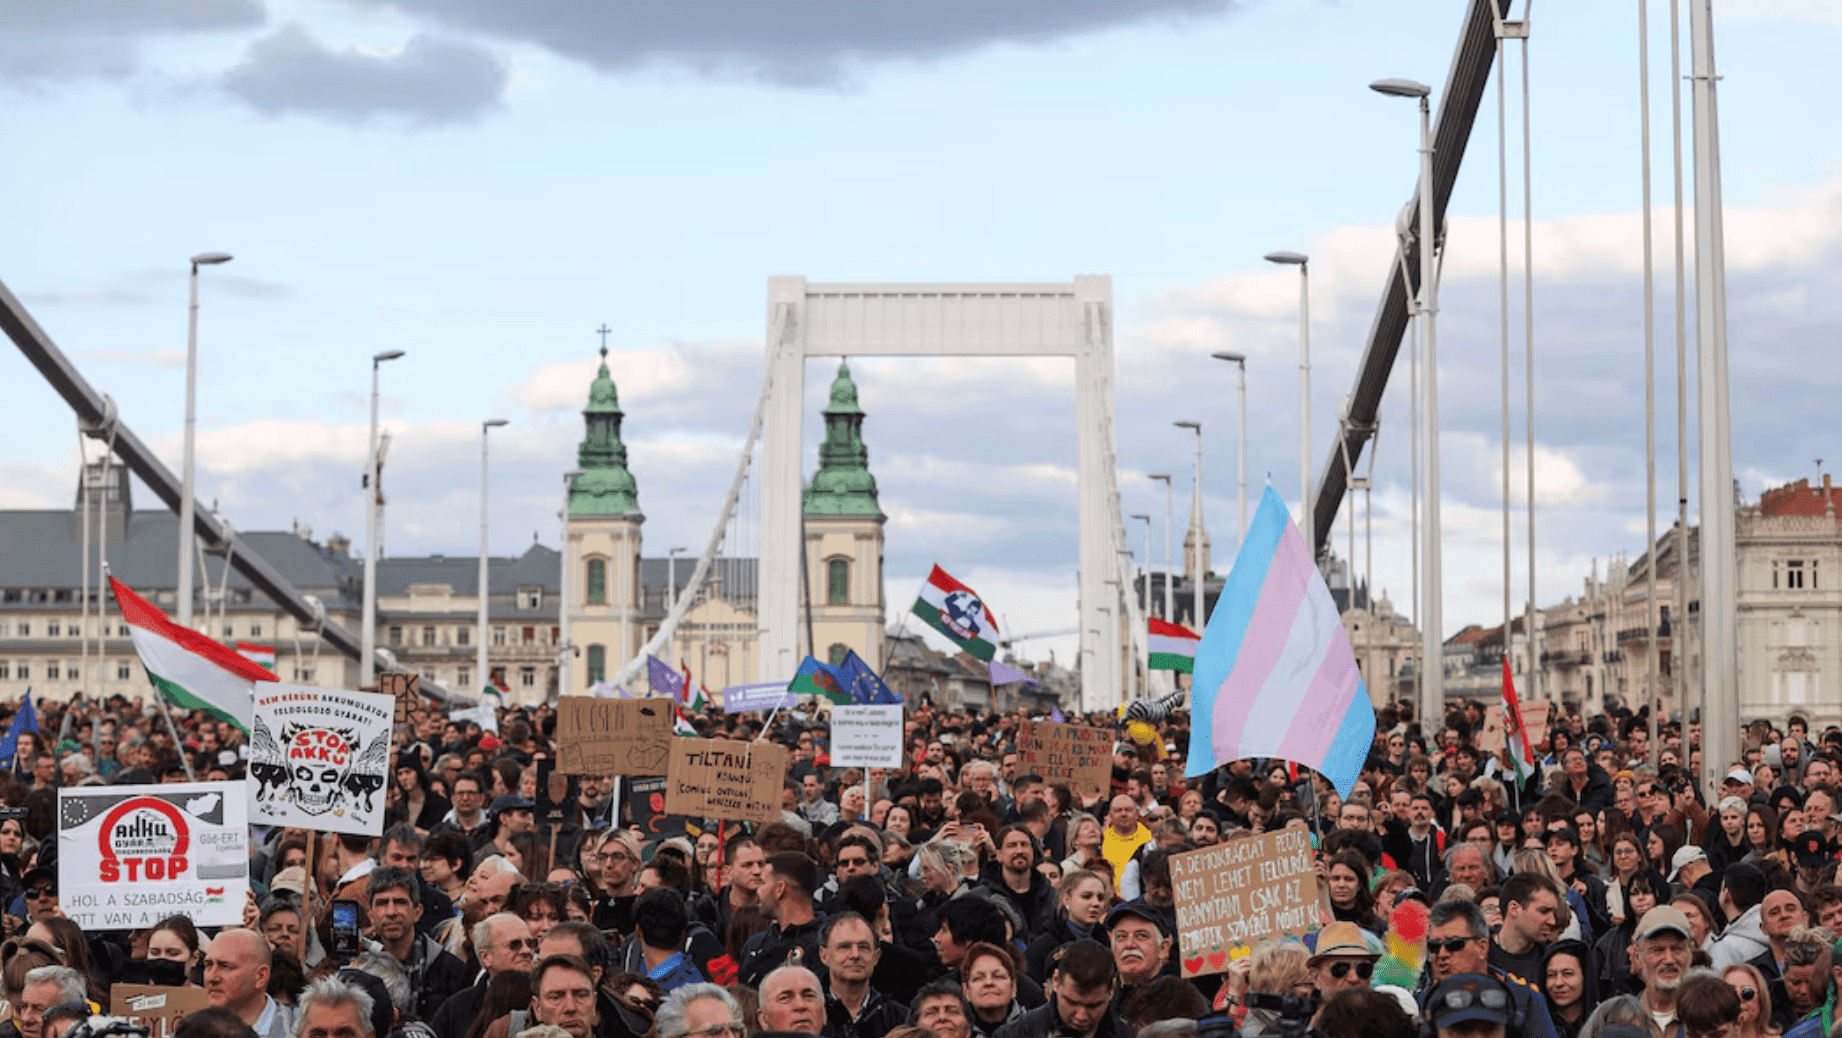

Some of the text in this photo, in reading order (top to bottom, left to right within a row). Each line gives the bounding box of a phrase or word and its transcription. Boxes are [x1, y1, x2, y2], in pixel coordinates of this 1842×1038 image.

[259, 695, 279, 706] NEM
[290, 745, 345, 765] AKKU
[115, 815, 167, 838] AKKU
[99, 856, 188, 882] STOP
[1175, 877, 1205, 902] NEM
[1213, 865, 1252, 893] LEHET
[107, 893, 117, 906] A
[1250, 884, 1281, 912] CSAK
[1286, 879, 1302, 903] AZ
[104, 912, 132, 925] VAN
[140, 912, 149, 924] A
